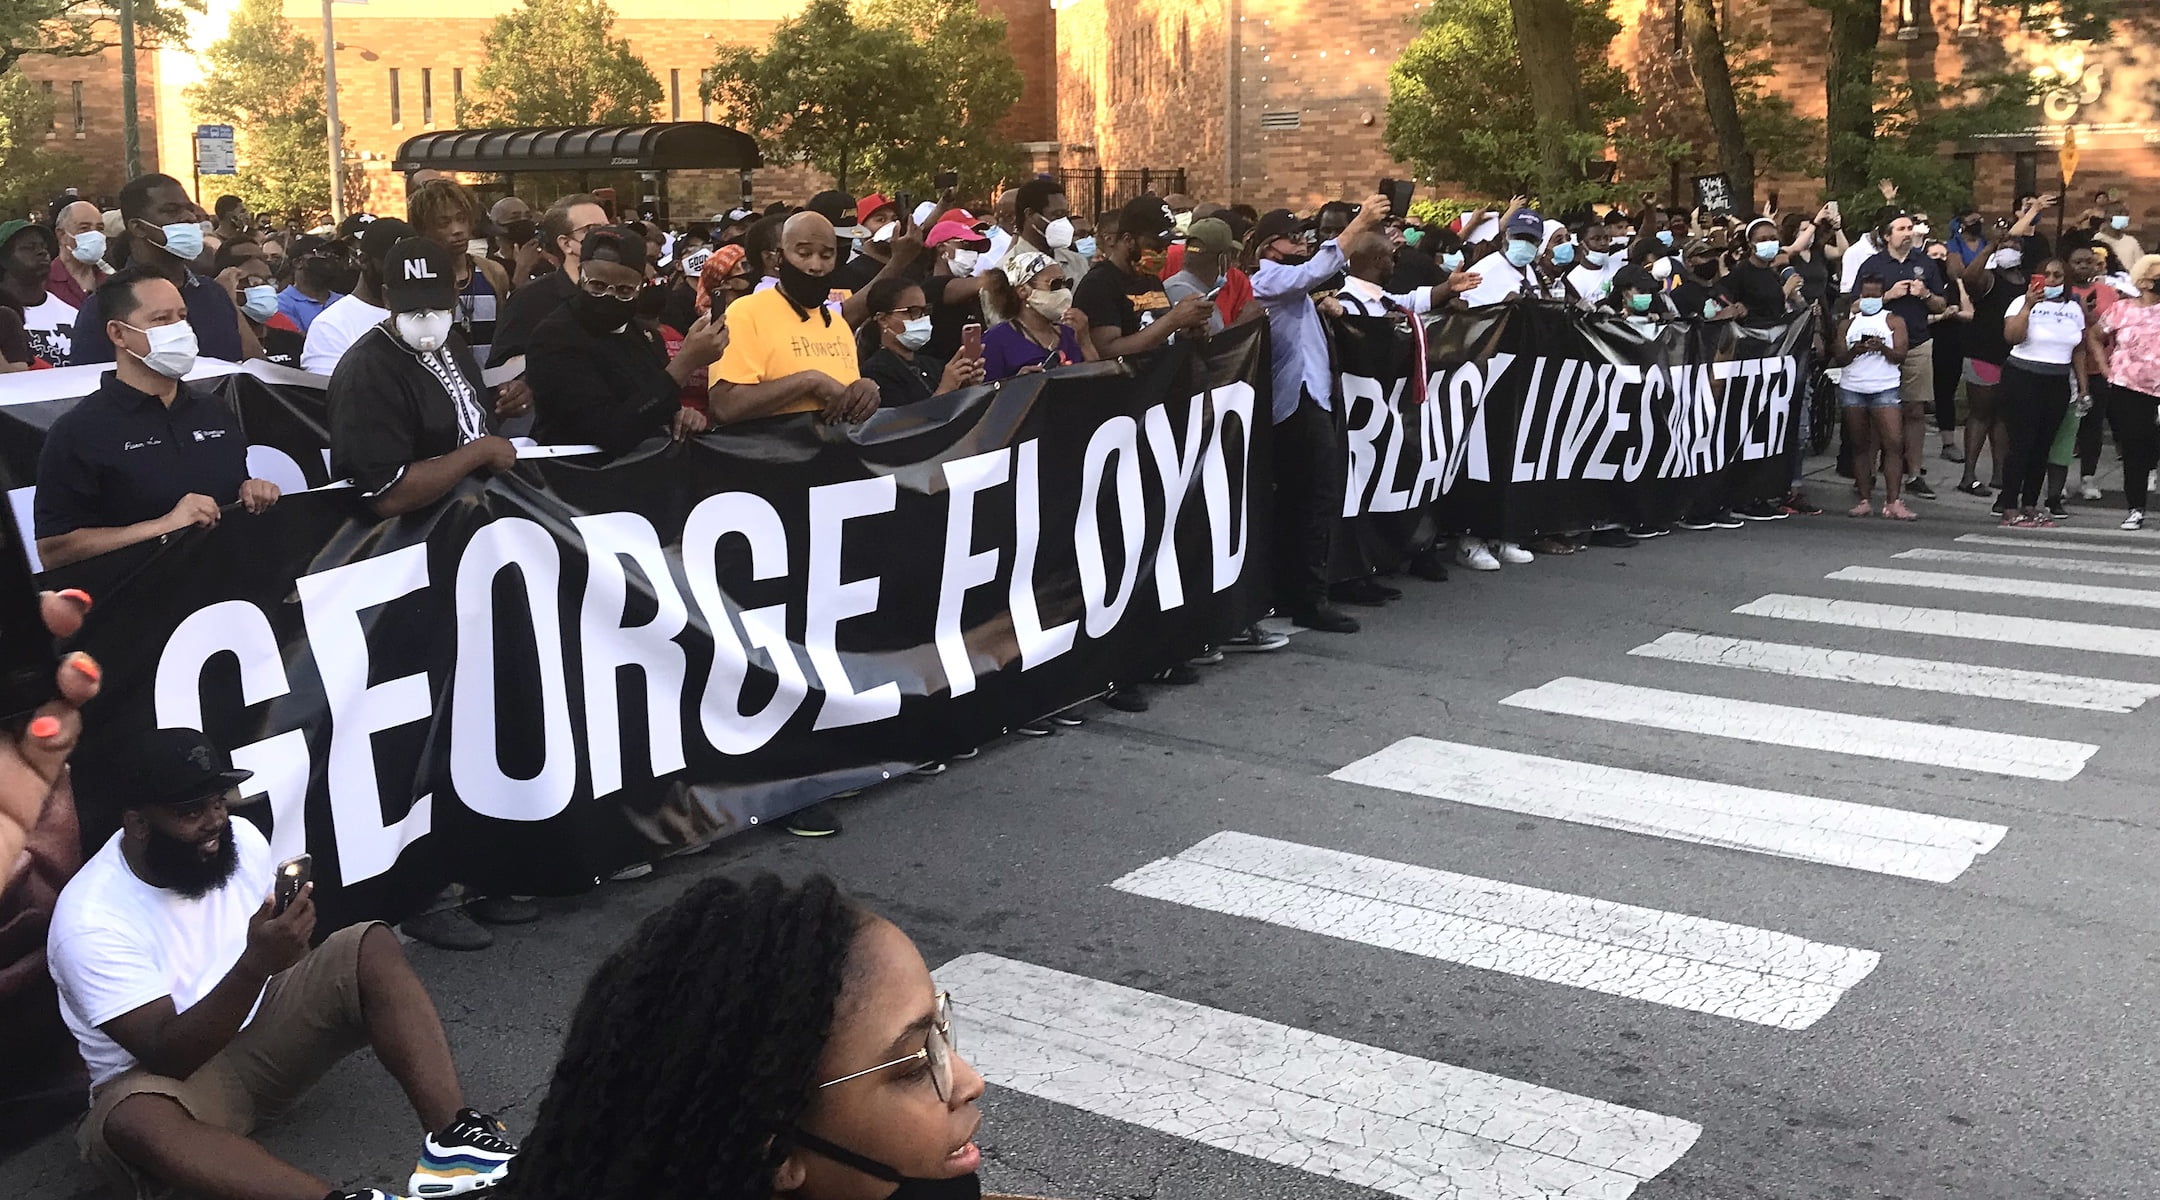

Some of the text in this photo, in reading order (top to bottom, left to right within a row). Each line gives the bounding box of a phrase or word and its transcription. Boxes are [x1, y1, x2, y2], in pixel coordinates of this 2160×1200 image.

[404, 258, 438, 280] NL
[1341, 352, 1517, 518] BLACK
[1511, 356, 1666, 483] LIVES
[155, 380, 1256, 887] GEORGE FLOYD
